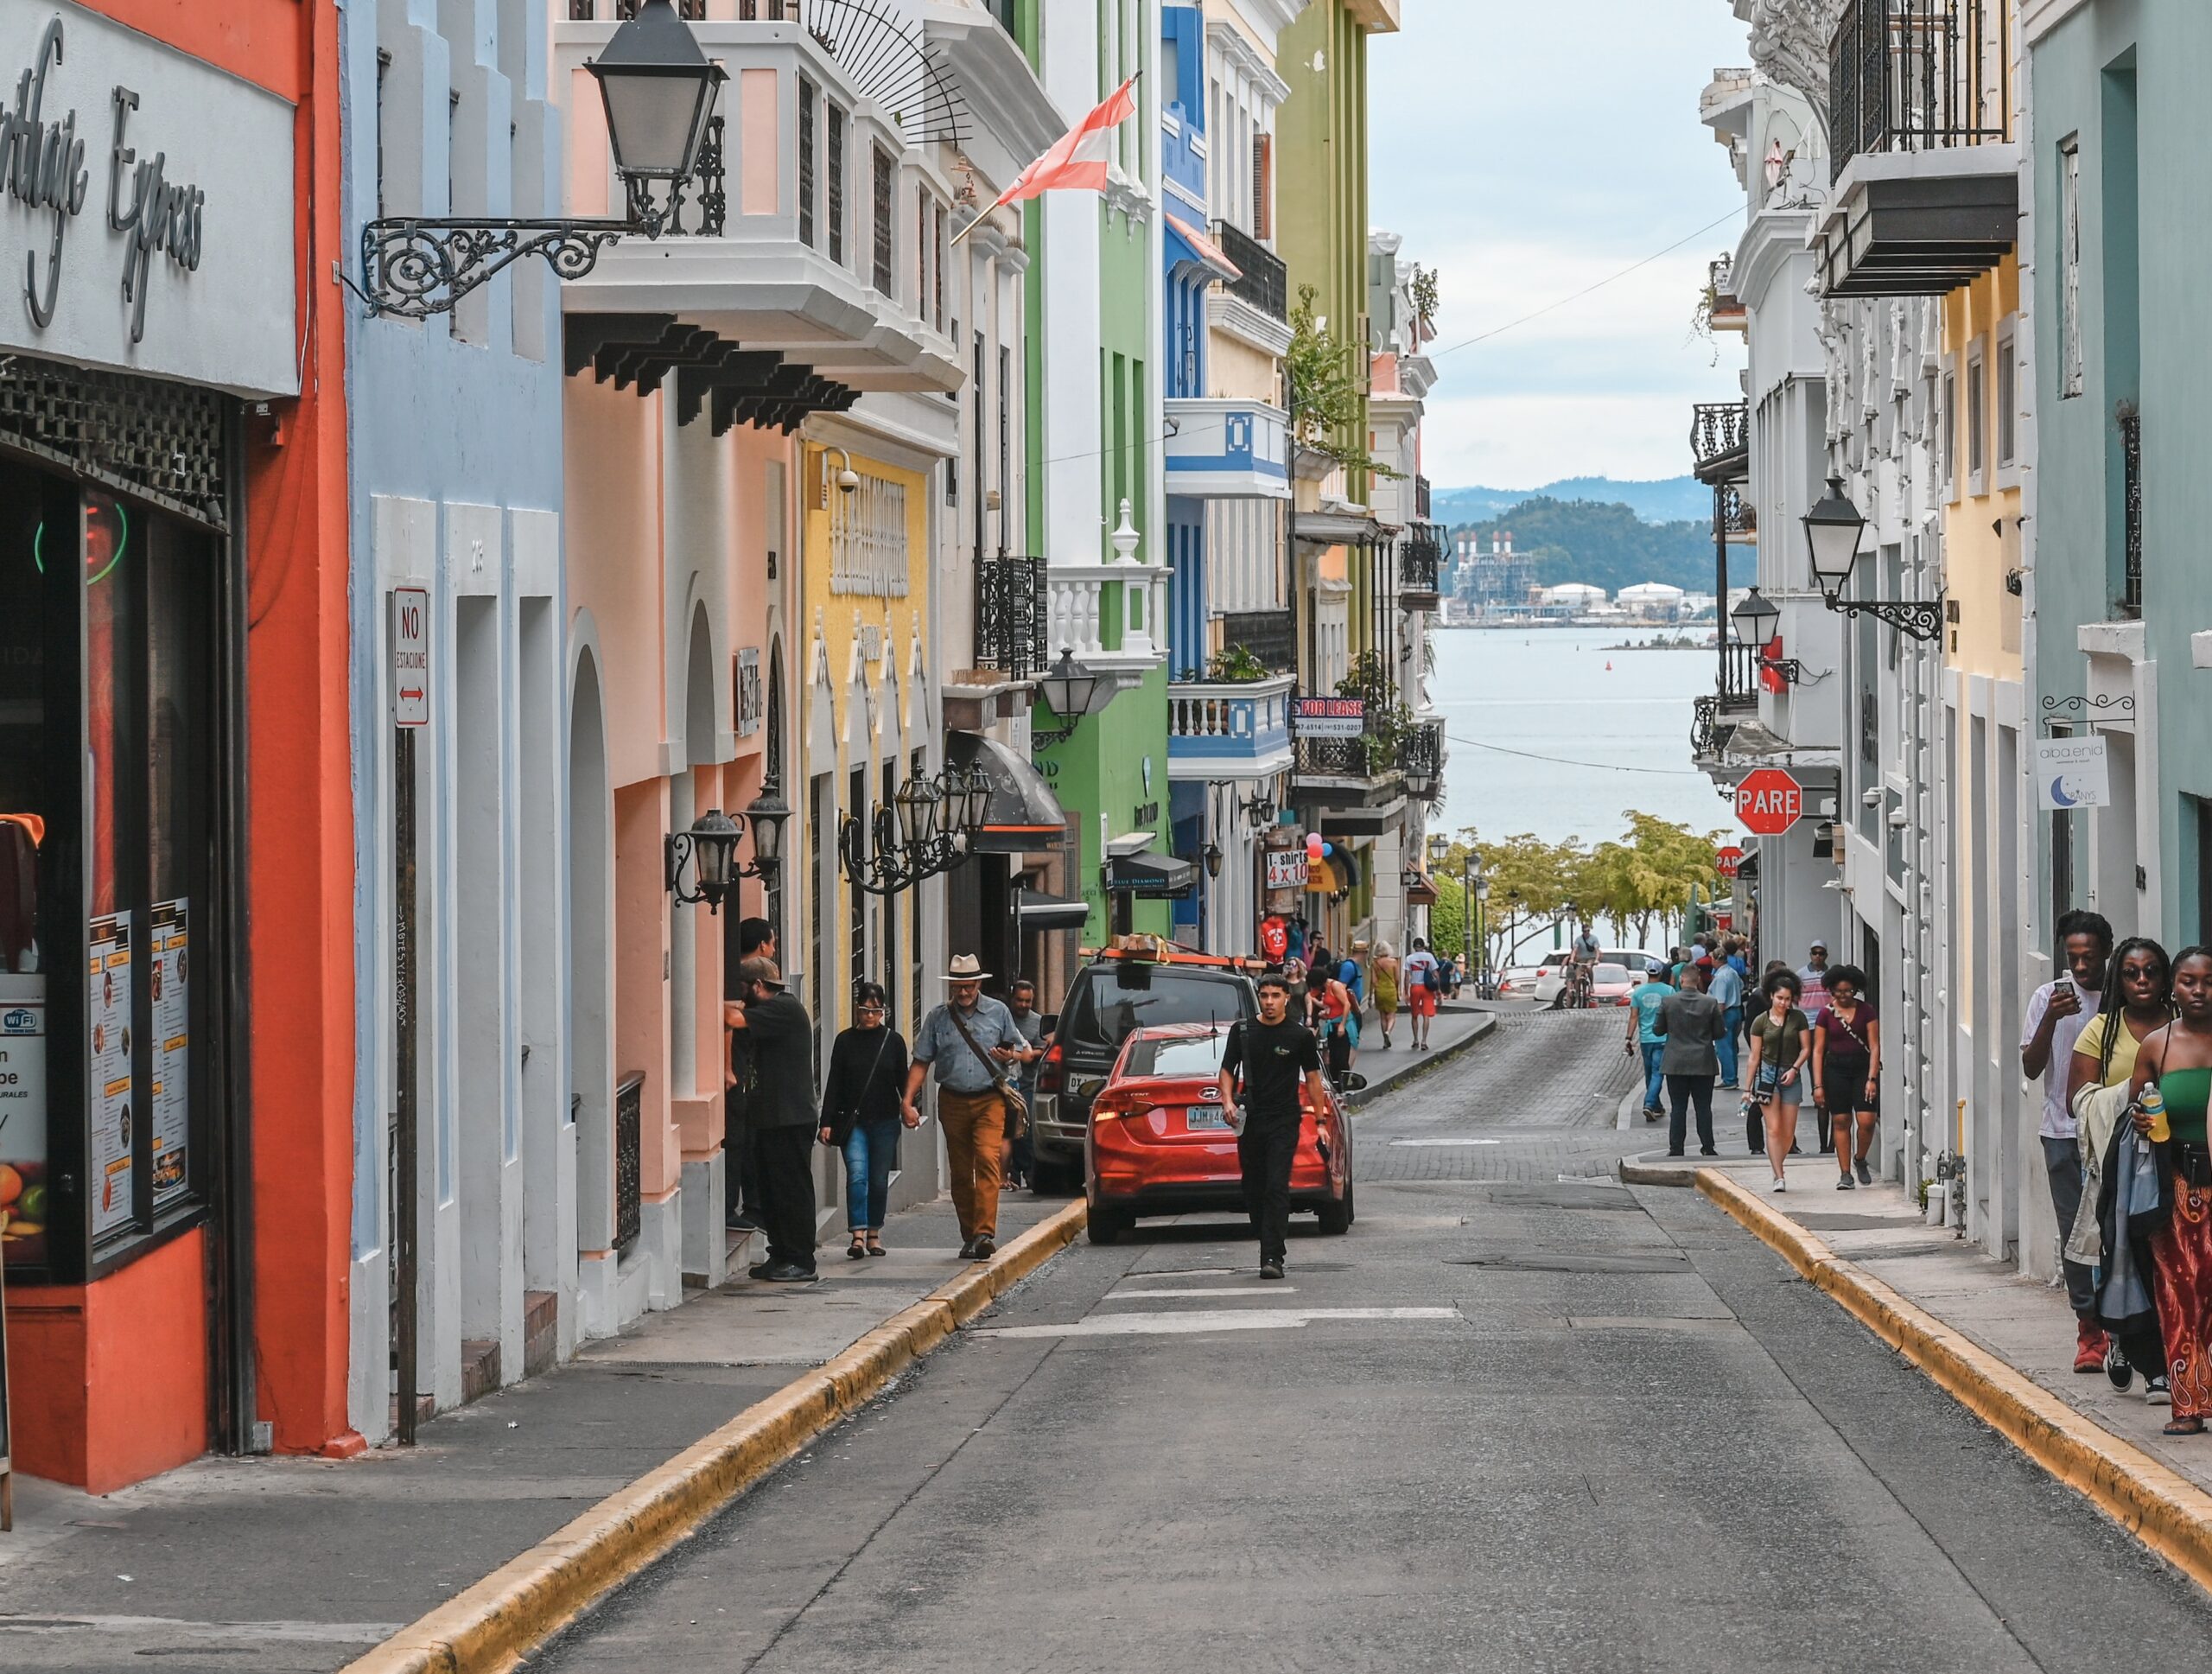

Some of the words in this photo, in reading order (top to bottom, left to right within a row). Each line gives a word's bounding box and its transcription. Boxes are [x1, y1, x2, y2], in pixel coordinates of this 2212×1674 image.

[402, 607, 419, 640] NO
[397, 652, 426, 669] ESTACIONE
[1301, 698, 1325, 716] FOR
[1327, 698, 1363, 716] LEASE
[1738, 790, 1798, 814] PARE
[1268, 854, 1277, 867] T-
[1280, 851, 1308, 865] shirts
[1716, 856, 1739, 868] PAR
[1268, 866, 1277, 882] 4
[1281, 869, 1288, 882] x
[1293, 863, 1307, 881] 10
